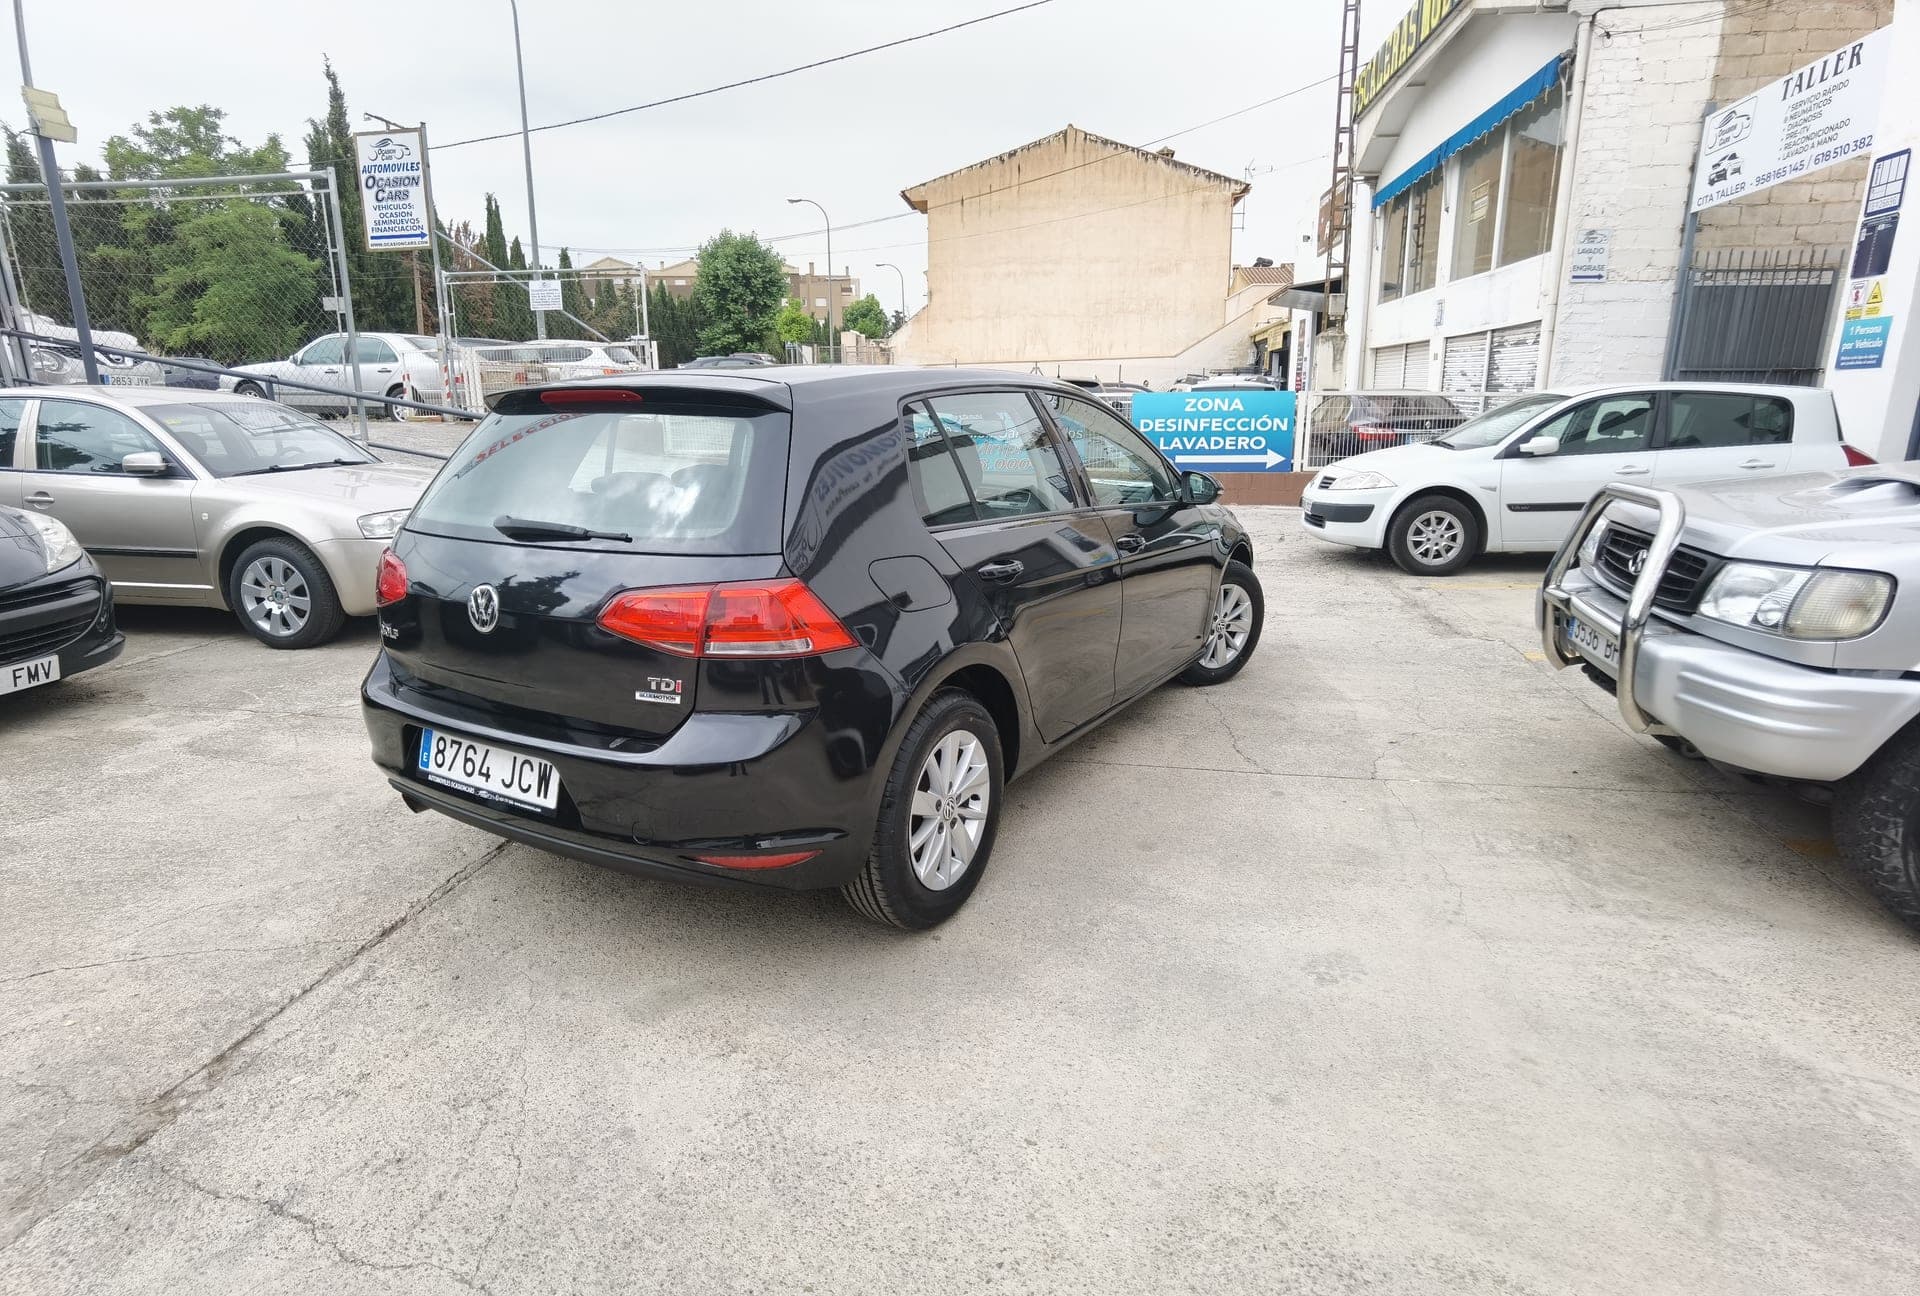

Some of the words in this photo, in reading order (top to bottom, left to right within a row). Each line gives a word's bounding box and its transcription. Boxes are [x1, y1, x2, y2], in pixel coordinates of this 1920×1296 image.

[1781, 42, 1864, 101] TALLER
[1791, 92, 1821, 112] SERVICIO
[1787, 110, 1823, 132] DIAGNOSIS
[1784, 118, 1851, 150] REACONDICIONADO
[1785, 125, 1811, 141] PRE-ITV
[1782, 144, 1809, 161] LAVADO
[1816, 132, 1839, 148] MANO
[361, 162, 421, 174] AUTOMOVILES
[1696, 194, 1714, 207] CITA
[1715, 182, 1746, 200] TALLER
[1755, 172, 1772, 187] 958
[1772, 166, 1787, 179] 165
[1789, 160, 1805, 173] 145
[1813, 150, 1832, 165] 618
[1832, 143, 1851, 159] 510
[1851, 135, 1874, 152] 382
[365, 175, 420, 189] OCASION
[375, 189, 410, 202] CARS
[373, 218, 420, 226] SEMINUEVOS
[1577, 247, 1605, 255] LAVADO
[1572, 264, 1607, 272] ENGRASE
[1855, 325, 1882, 335] Persona
[1841, 342, 1854, 353] por
[1855, 337, 1883, 348] Vehículo
[1184, 397, 1245, 412] ZONA
[1139, 414, 1289, 433] DESINFECCIÓN
[1159, 436, 1267, 450] LAVADERO
[12, 660, 52, 688] FMV
[434, 736, 491, 783] 8764
[501, 755, 553, 800] JCW
